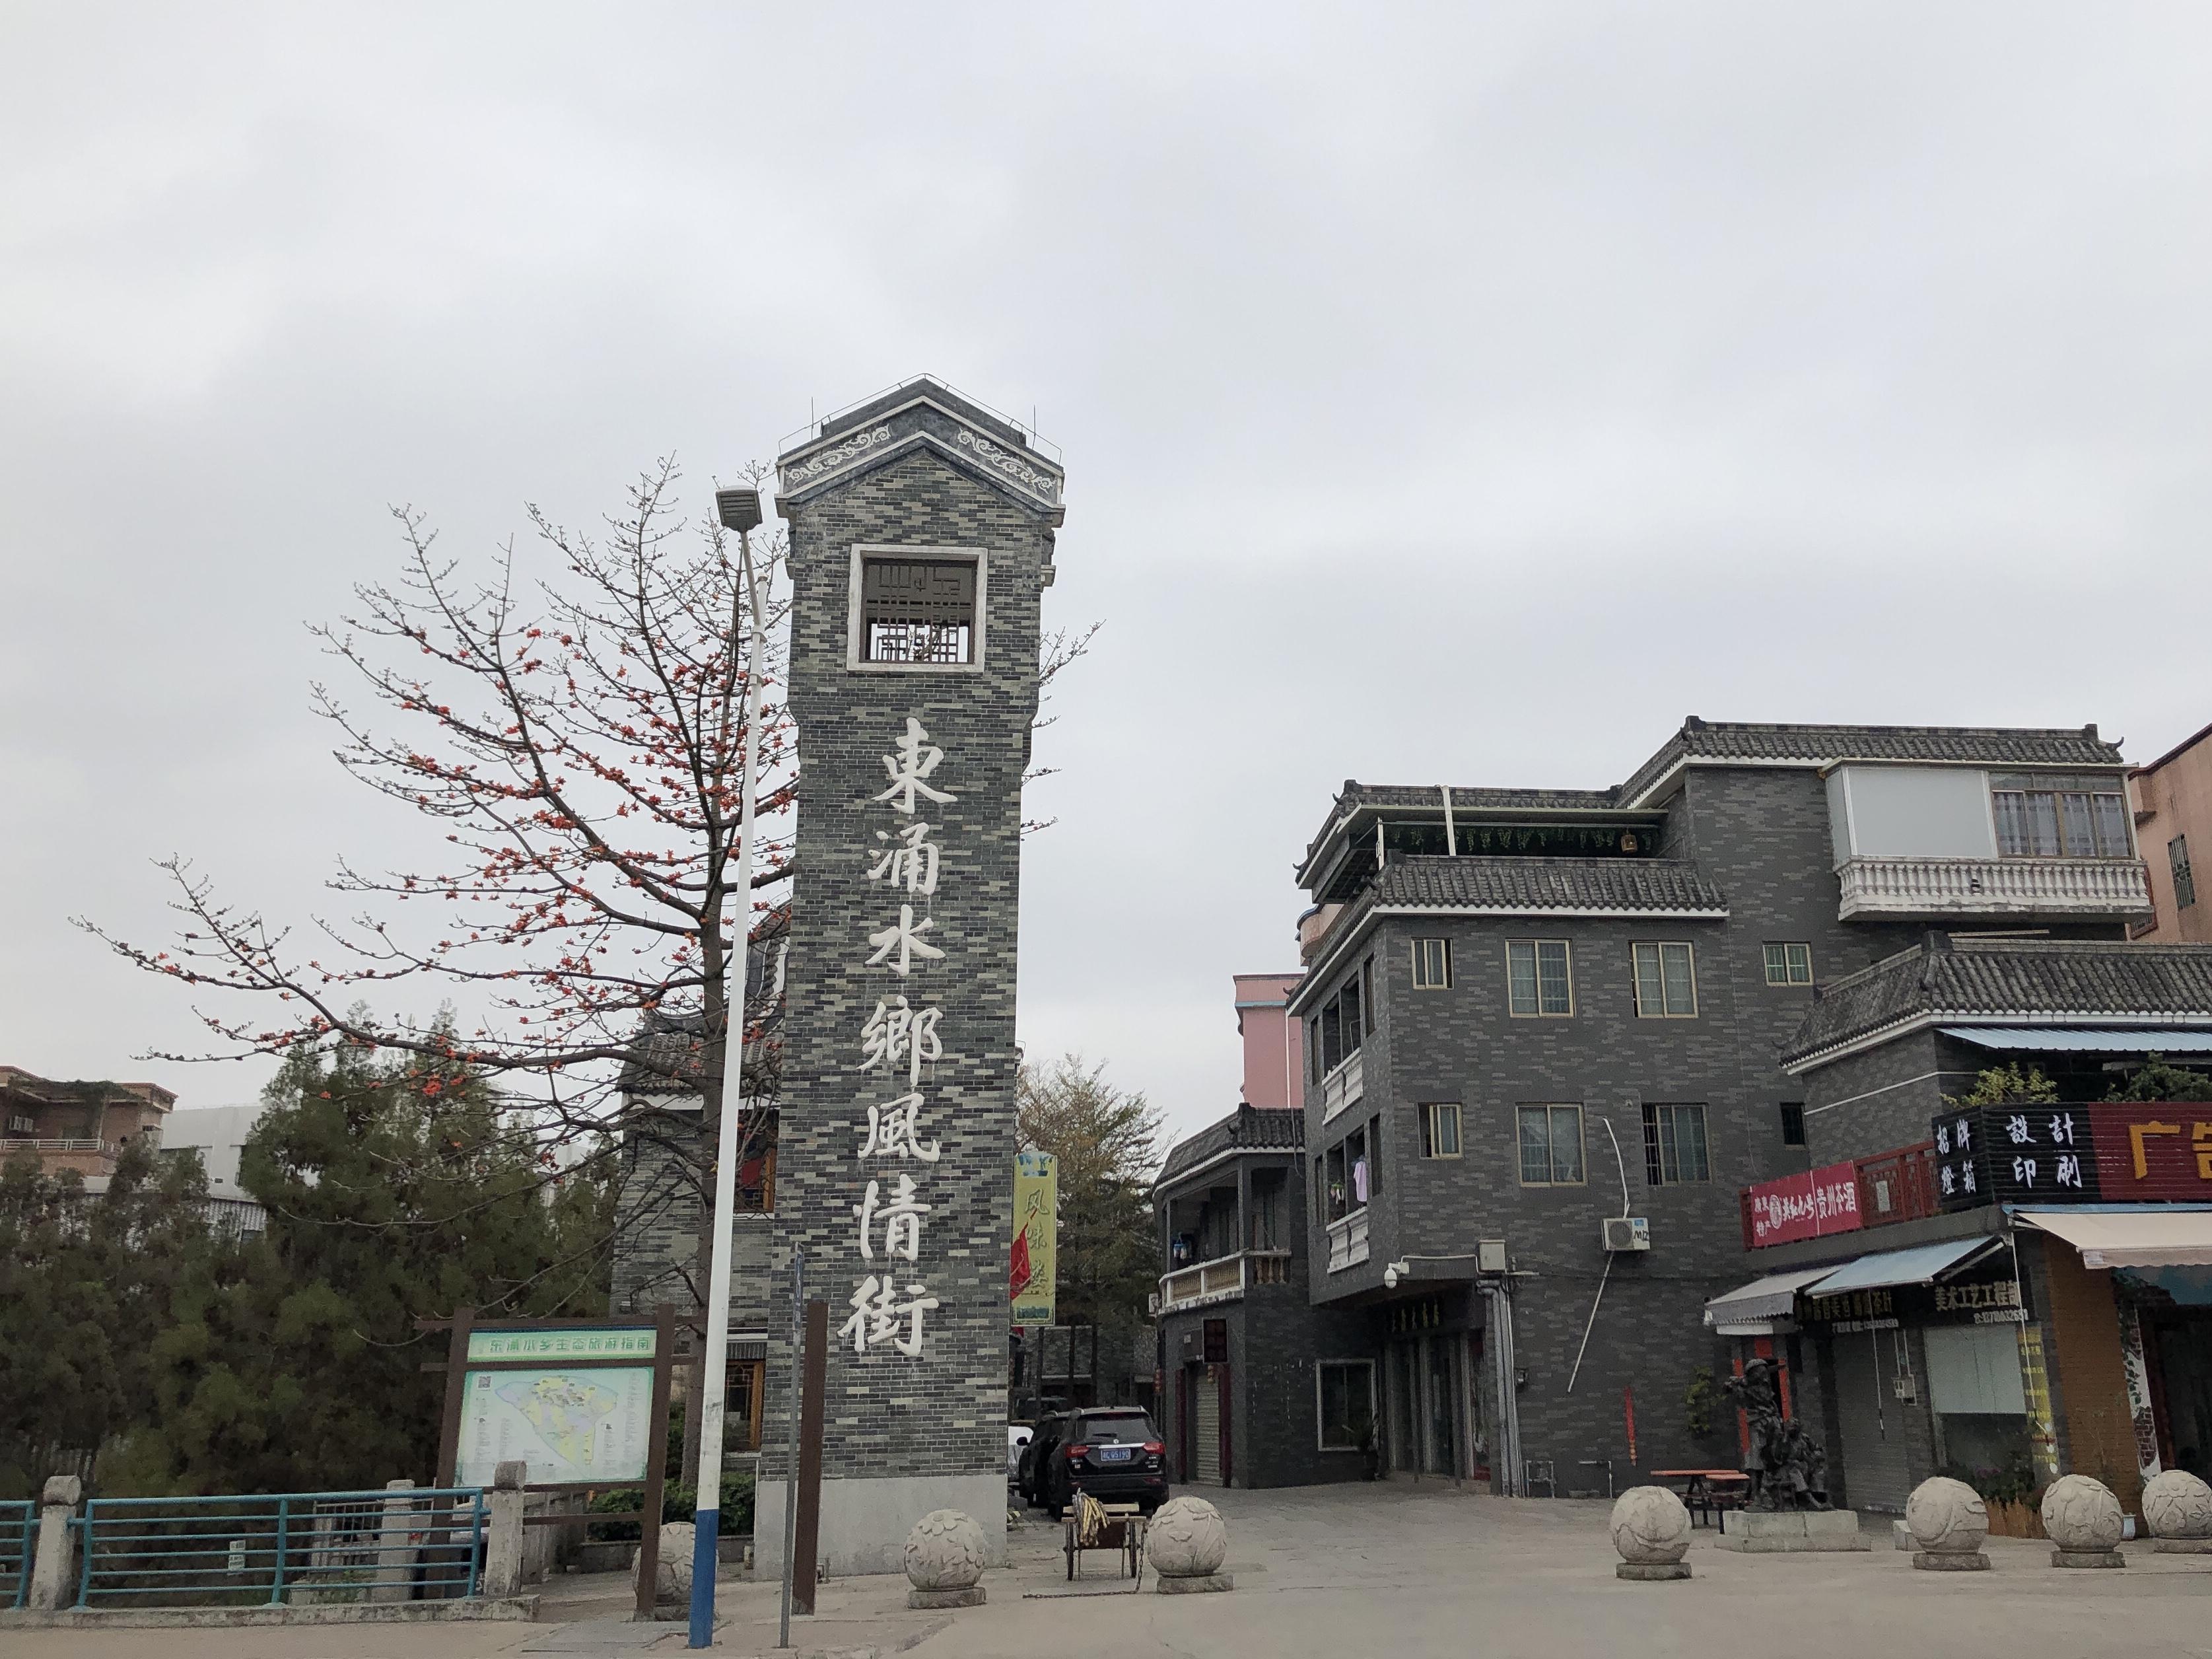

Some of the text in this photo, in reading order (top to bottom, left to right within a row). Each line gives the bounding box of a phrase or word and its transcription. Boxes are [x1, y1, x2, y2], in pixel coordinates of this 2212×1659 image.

[837, 716, 958, 1358] 東涌水鄉風情街
[1937, 1119, 1971, 1155] 招牌
[2006, 1112, 2075, 1145] 設計
[2013, 1154, 2083, 1189] 印刷
[1816, 1181, 1857, 1219] 贵州茶酒
[489, 1336, 651, 1353] 东涌水乡生态旅游指南
